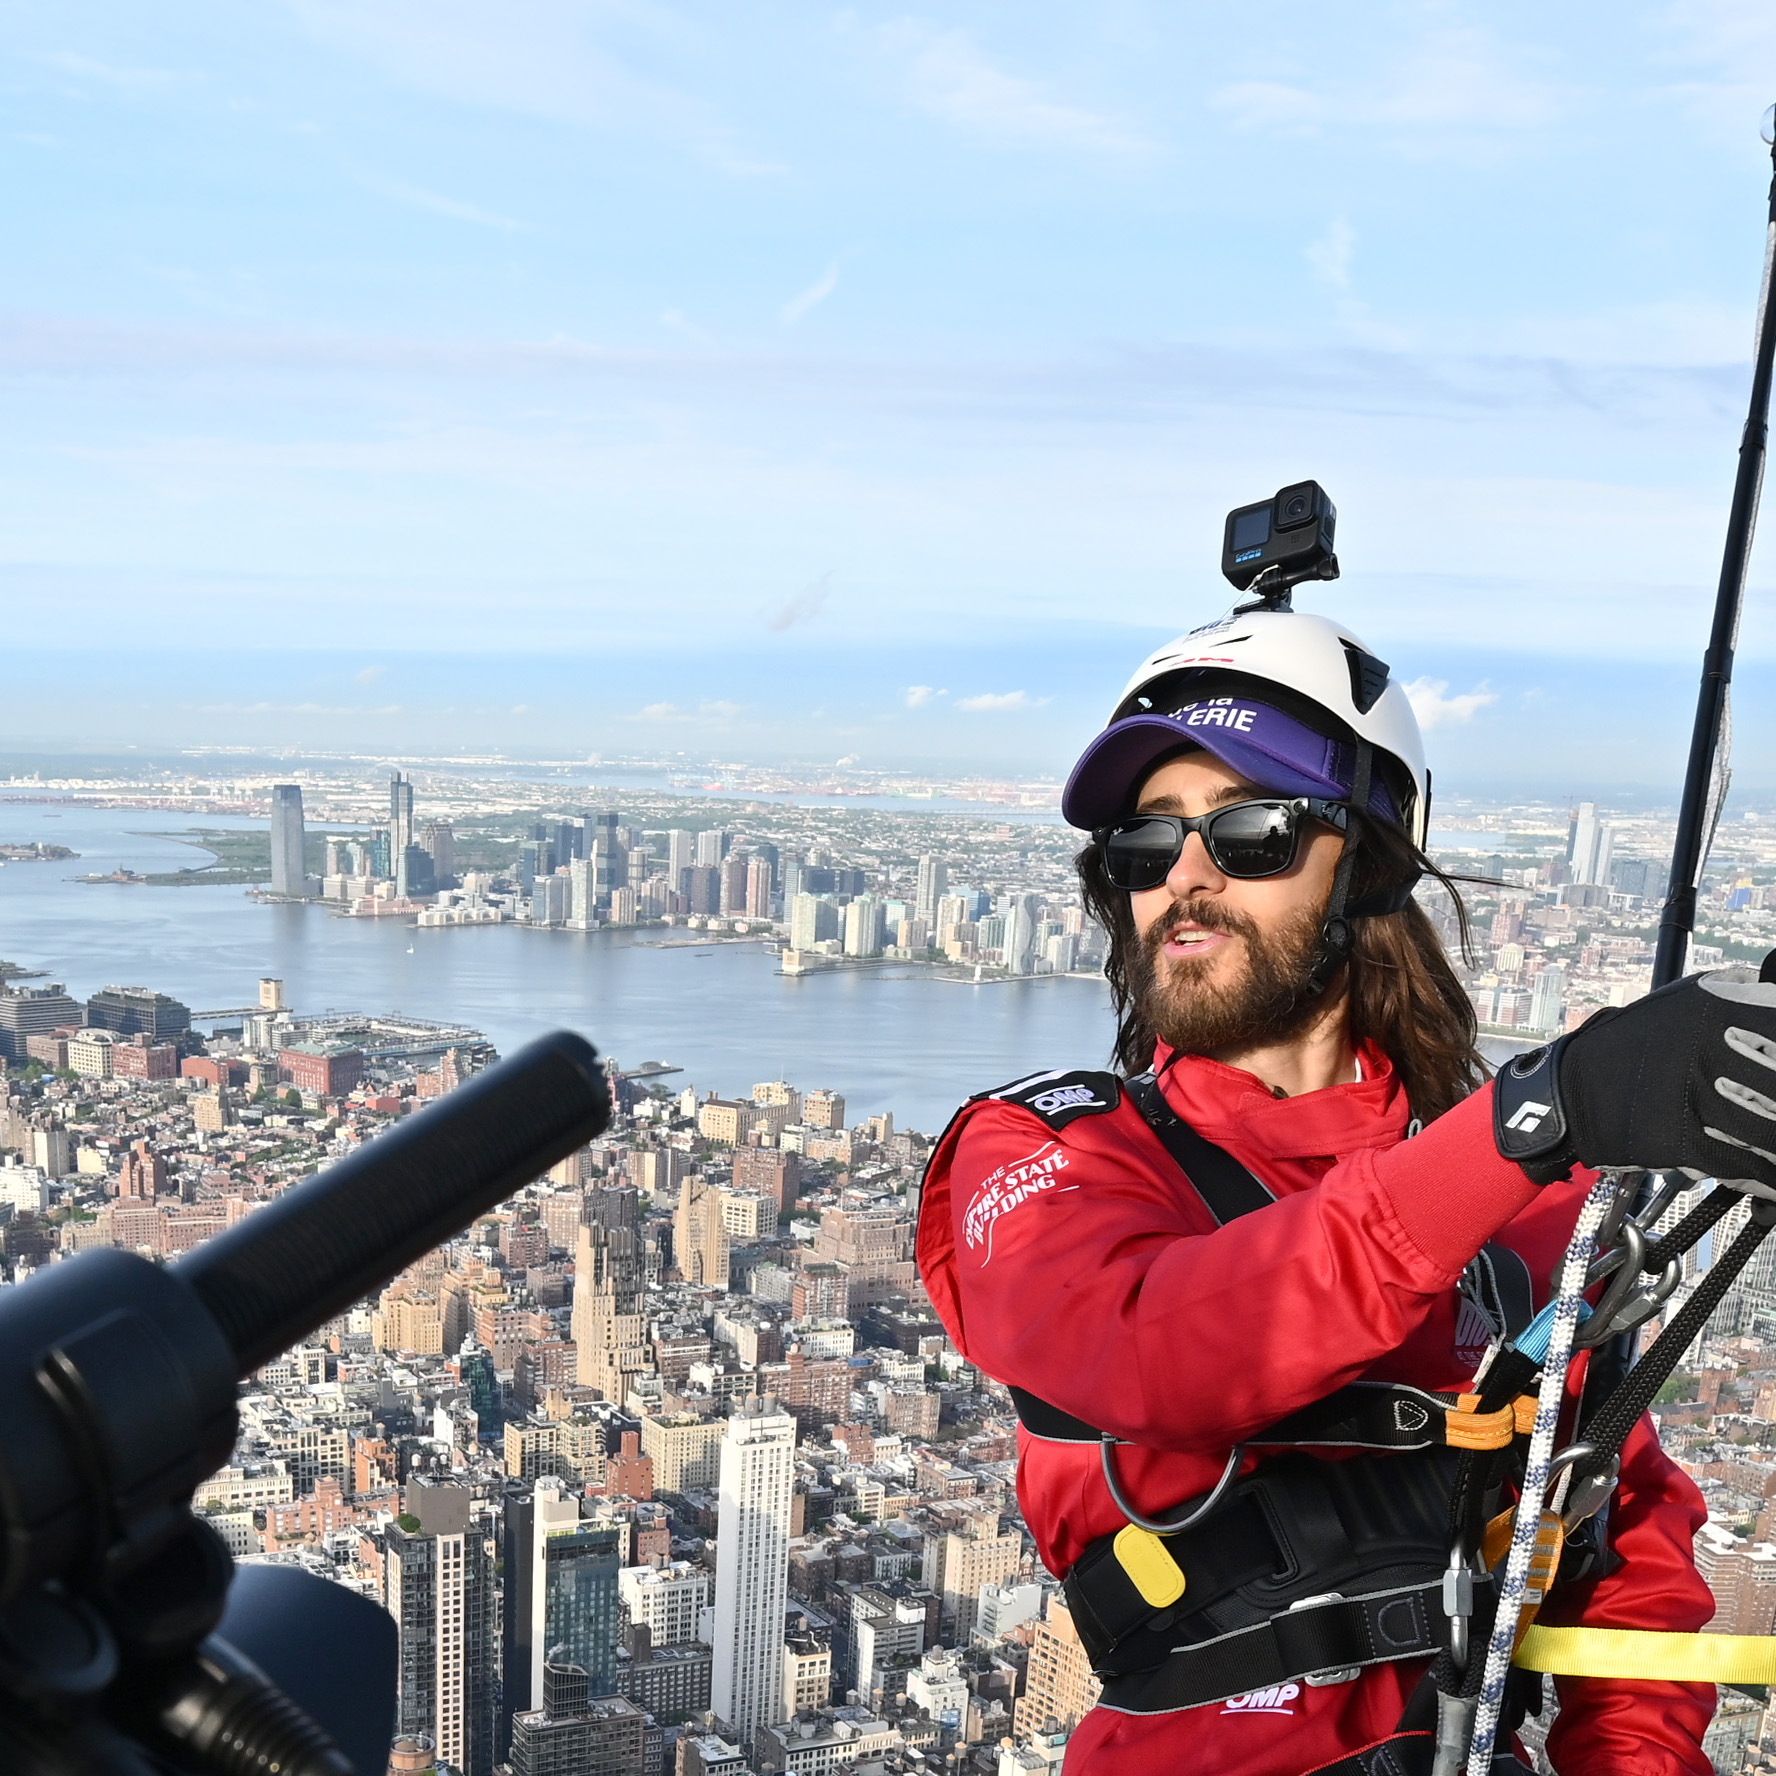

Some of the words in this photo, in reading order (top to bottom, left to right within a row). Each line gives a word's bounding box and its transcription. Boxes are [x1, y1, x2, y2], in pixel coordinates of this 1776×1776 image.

[1176, 708, 1257, 732] ERIE
[1035, 1087, 1095, 1112] OMP
[981, 1165, 1006, 1189] THE
[965, 1182, 1005, 1250] EMPIRE
[1006, 1149, 1070, 1190] STATE
[973, 1174, 1056, 1245] BUILDING
